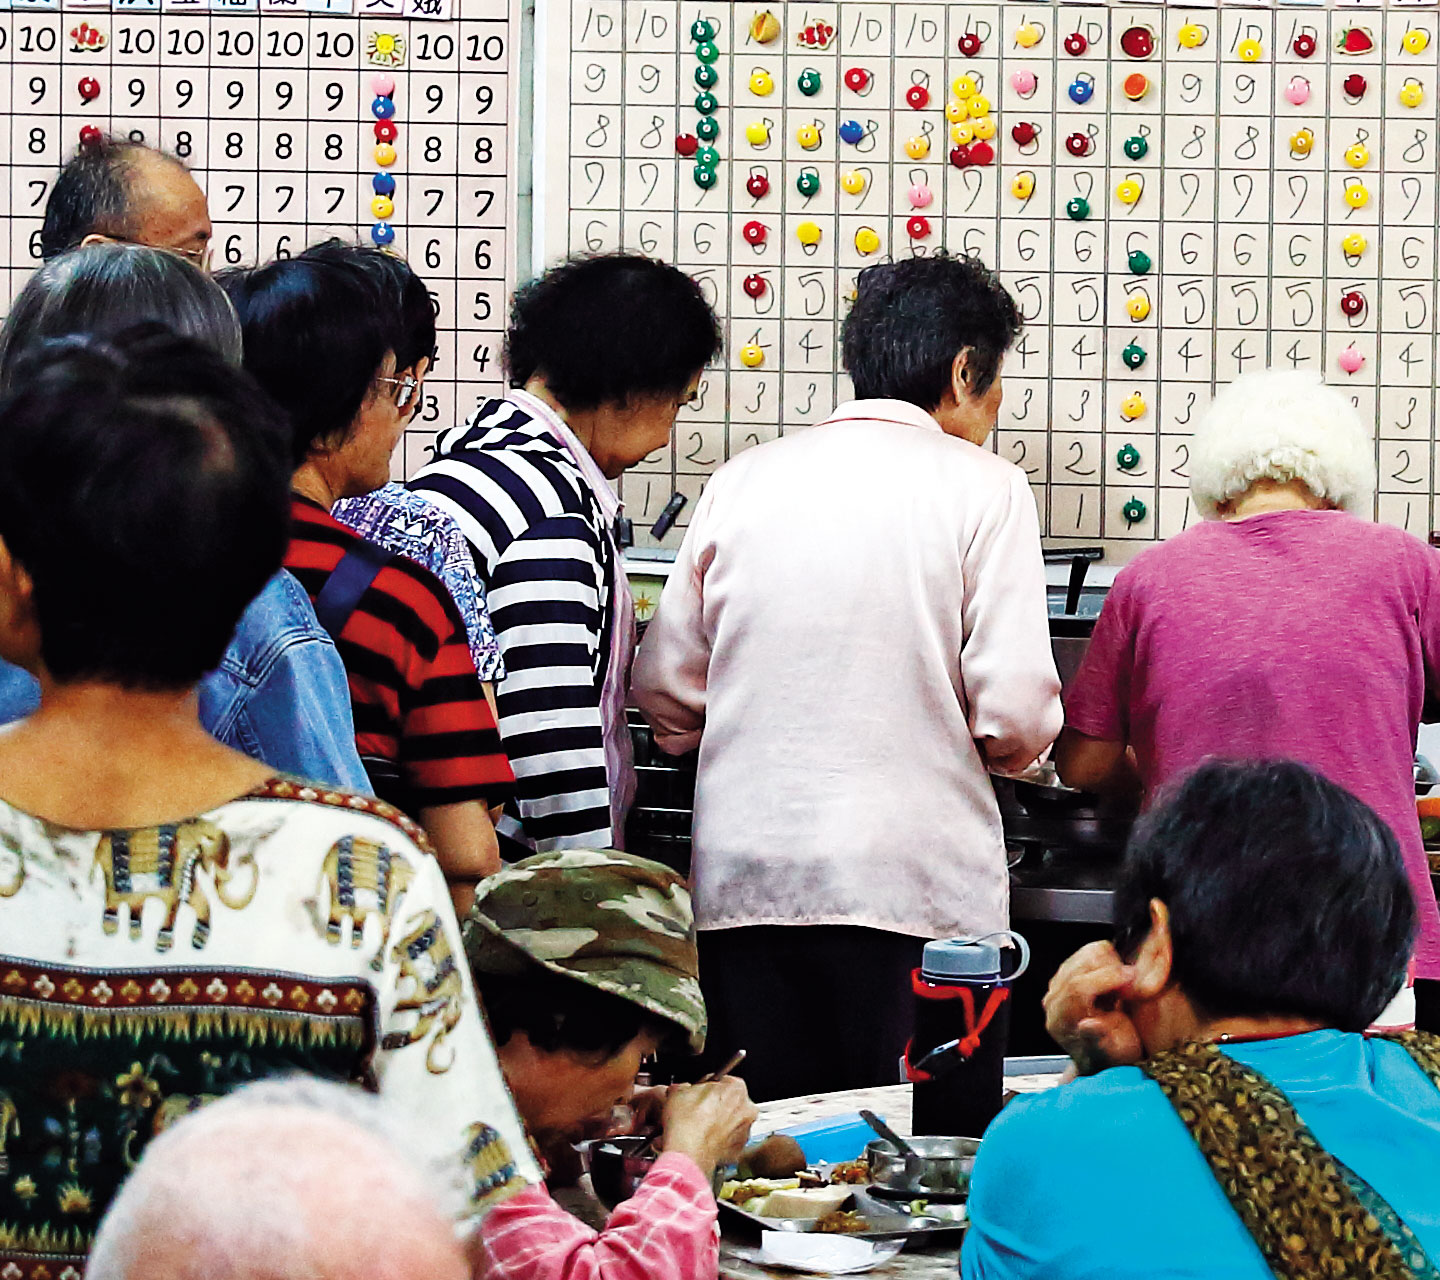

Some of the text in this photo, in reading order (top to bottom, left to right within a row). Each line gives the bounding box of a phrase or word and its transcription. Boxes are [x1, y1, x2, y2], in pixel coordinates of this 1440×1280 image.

[19, 25, 56, 52] 10
[118, 28, 155, 54] 10
[167, 29, 204, 55] 10
[217, 30, 254, 56] 10
[266, 30, 303, 57] 10
[316, 31, 354, 58] 10
[416, 34, 454, 60] 10
[466, 35, 504, 61] 10
[585, 14, 614, 46] 10
[634, 8, 667, 46] 10
[849, 11, 882, 47] 10
[905, 13, 938, 48] 10
[128, 78, 145, 107] 9
[176, 80, 193, 108] 9
[584, 63, 606, 94] 9
[638, 63, 661, 94] 9
[424, 136, 442, 163] 8
[474, 137, 492, 164] 8
[473, 292, 491, 320] 5
[473, 344, 490, 373] 4
